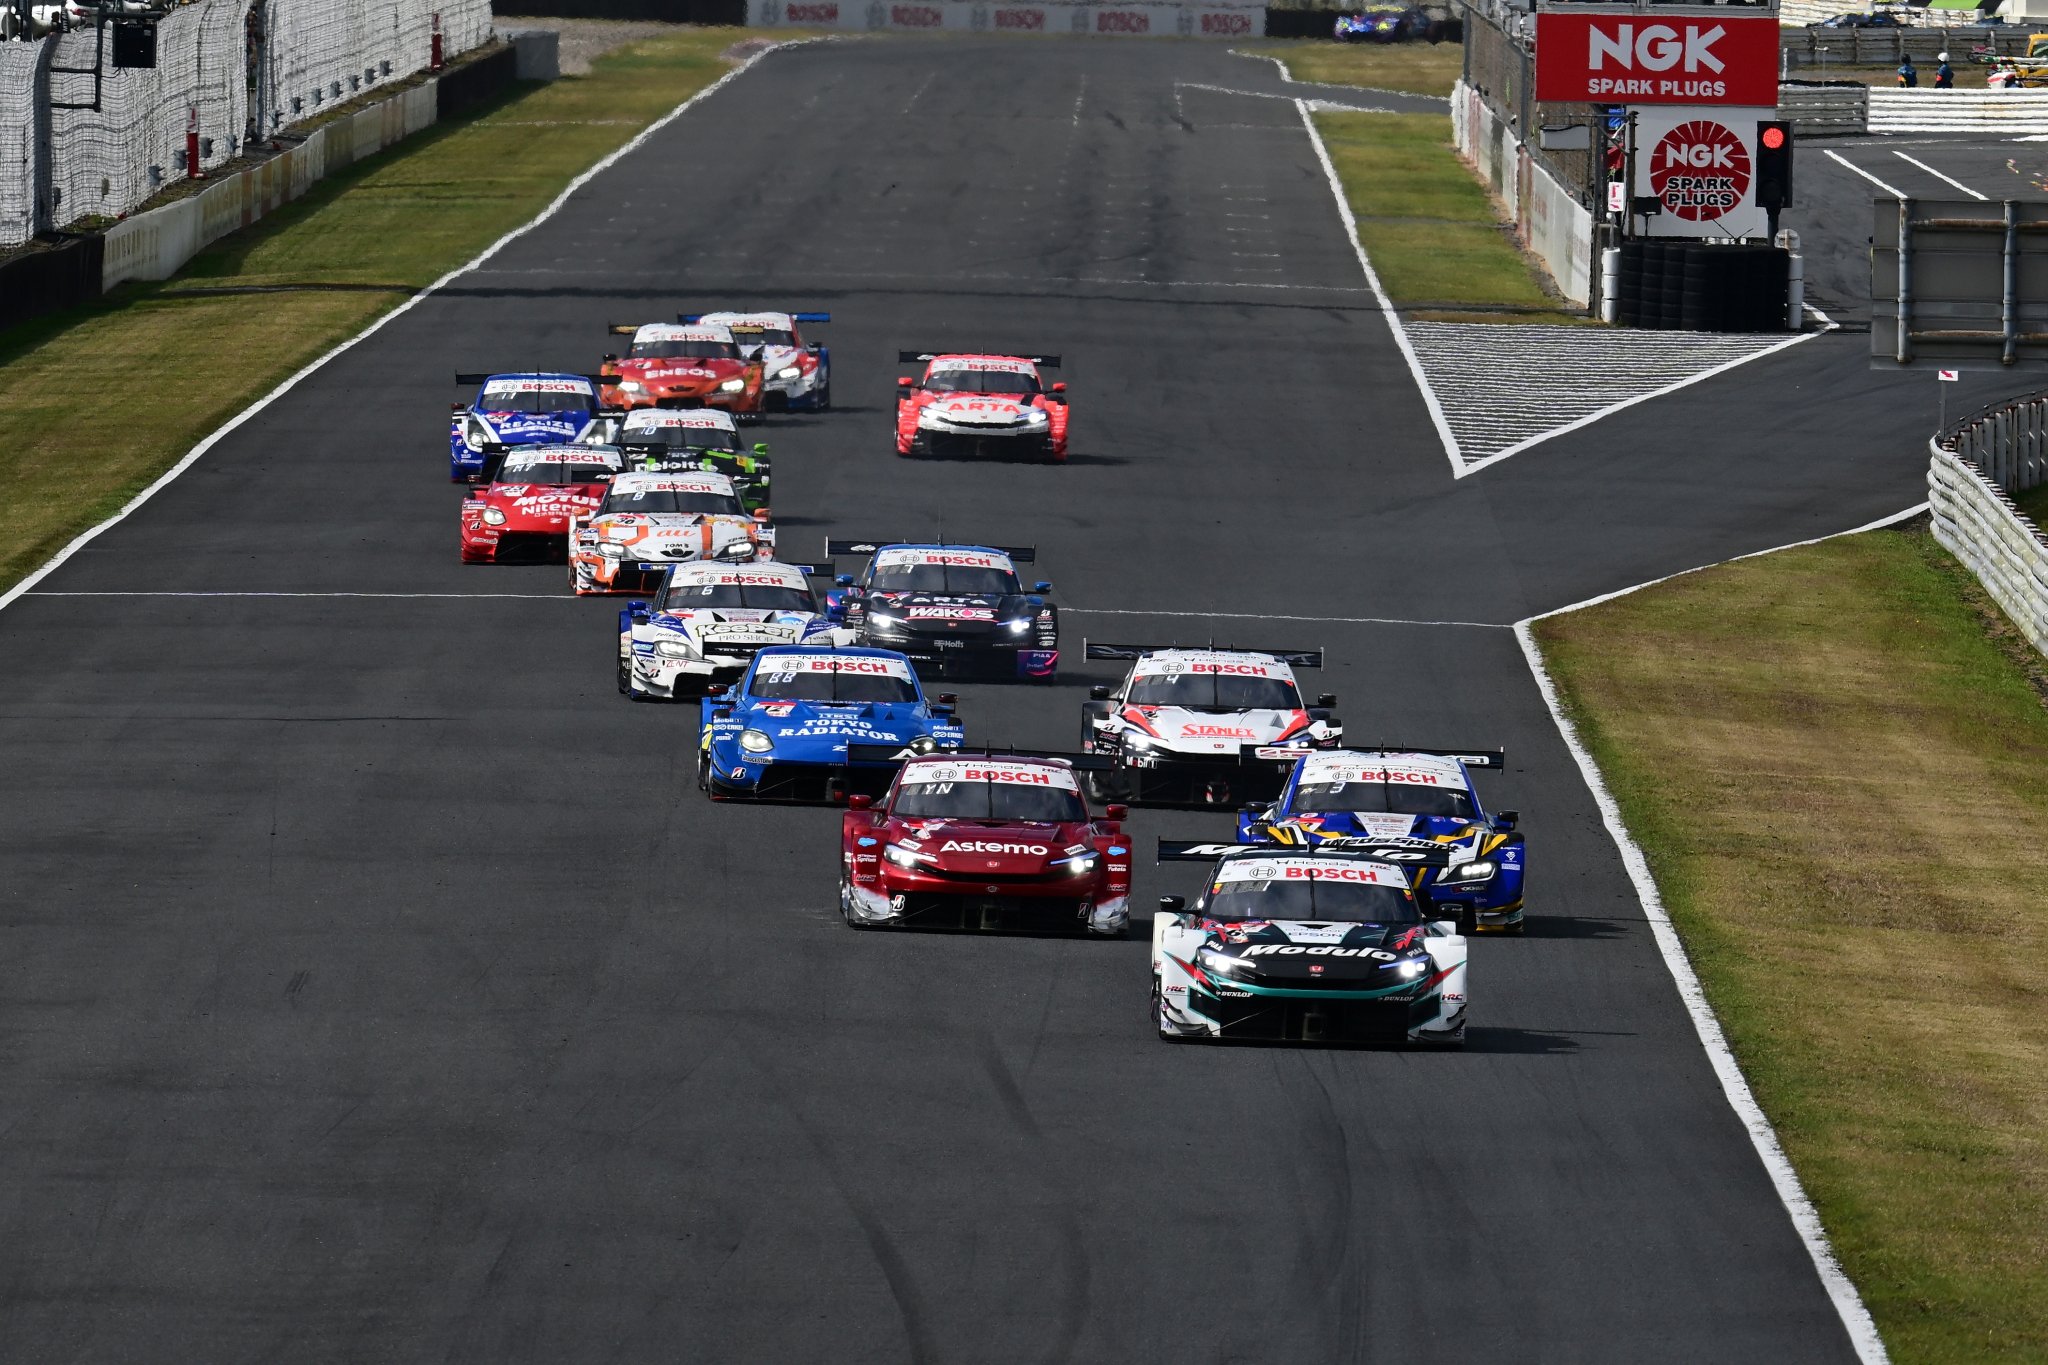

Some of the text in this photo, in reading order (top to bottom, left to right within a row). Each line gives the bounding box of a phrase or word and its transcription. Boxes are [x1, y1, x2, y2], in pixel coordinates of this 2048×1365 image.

[1588, 24, 1726, 75] NGK
[1588, 78, 1726, 97] SPARK PLUGS
[1666, 143, 1735, 169] NGK
[1667, 176, 1734, 191] SPARK
[1667, 192, 1734, 207] PLUGS
[645, 367, 717, 379] ENEOS
[968, 363, 1019, 372] BOSCH
[522, 383, 576, 391] BOSCH
[948, 403, 1020, 414] ARTA
[500, 420, 575, 430] REALIZE
[665, 419, 715, 428] BOSCH
[545, 455, 605, 463] BOSCH
[656, 483, 712, 491] BOSCH
[512, 495, 601, 507] MOTUL
[656, 529, 696, 538] au
[926, 555, 991, 566] BOSCH
[720, 576, 784, 585] BOSCH
[912, 596, 988, 605] ARTA
[666, 659, 689, 668] ZENT
[811, 661, 888, 674] BOSCH
[1191, 664, 1267, 676] BOSCH
[1166, 674, 1180, 684] 4
[803, 718, 873, 729] TOKYO
[778, 727, 900, 742] RADIATOR
[1181, 723, 1256, 738] STANLEY
[1126, 755, 1148, 769] Mobil
[965, 770, 1050, 785] BOSCH
[1361, 771, 1438, 785] BOSCH
[940, 840, 1048, 856] Astemo
[1285, 867, 1378, 883] BOSCH
[1206, 940, 1224, 952] PIAA
[1406, 946, 1425, 958] PIAA
[1239, 944, 1397, 962] Modulo
[1165, 985, 1188, 993] HRC
[1220, 990, 1254, 998] DUNLOP
[1441, 993, 1464, 1001] HRC
